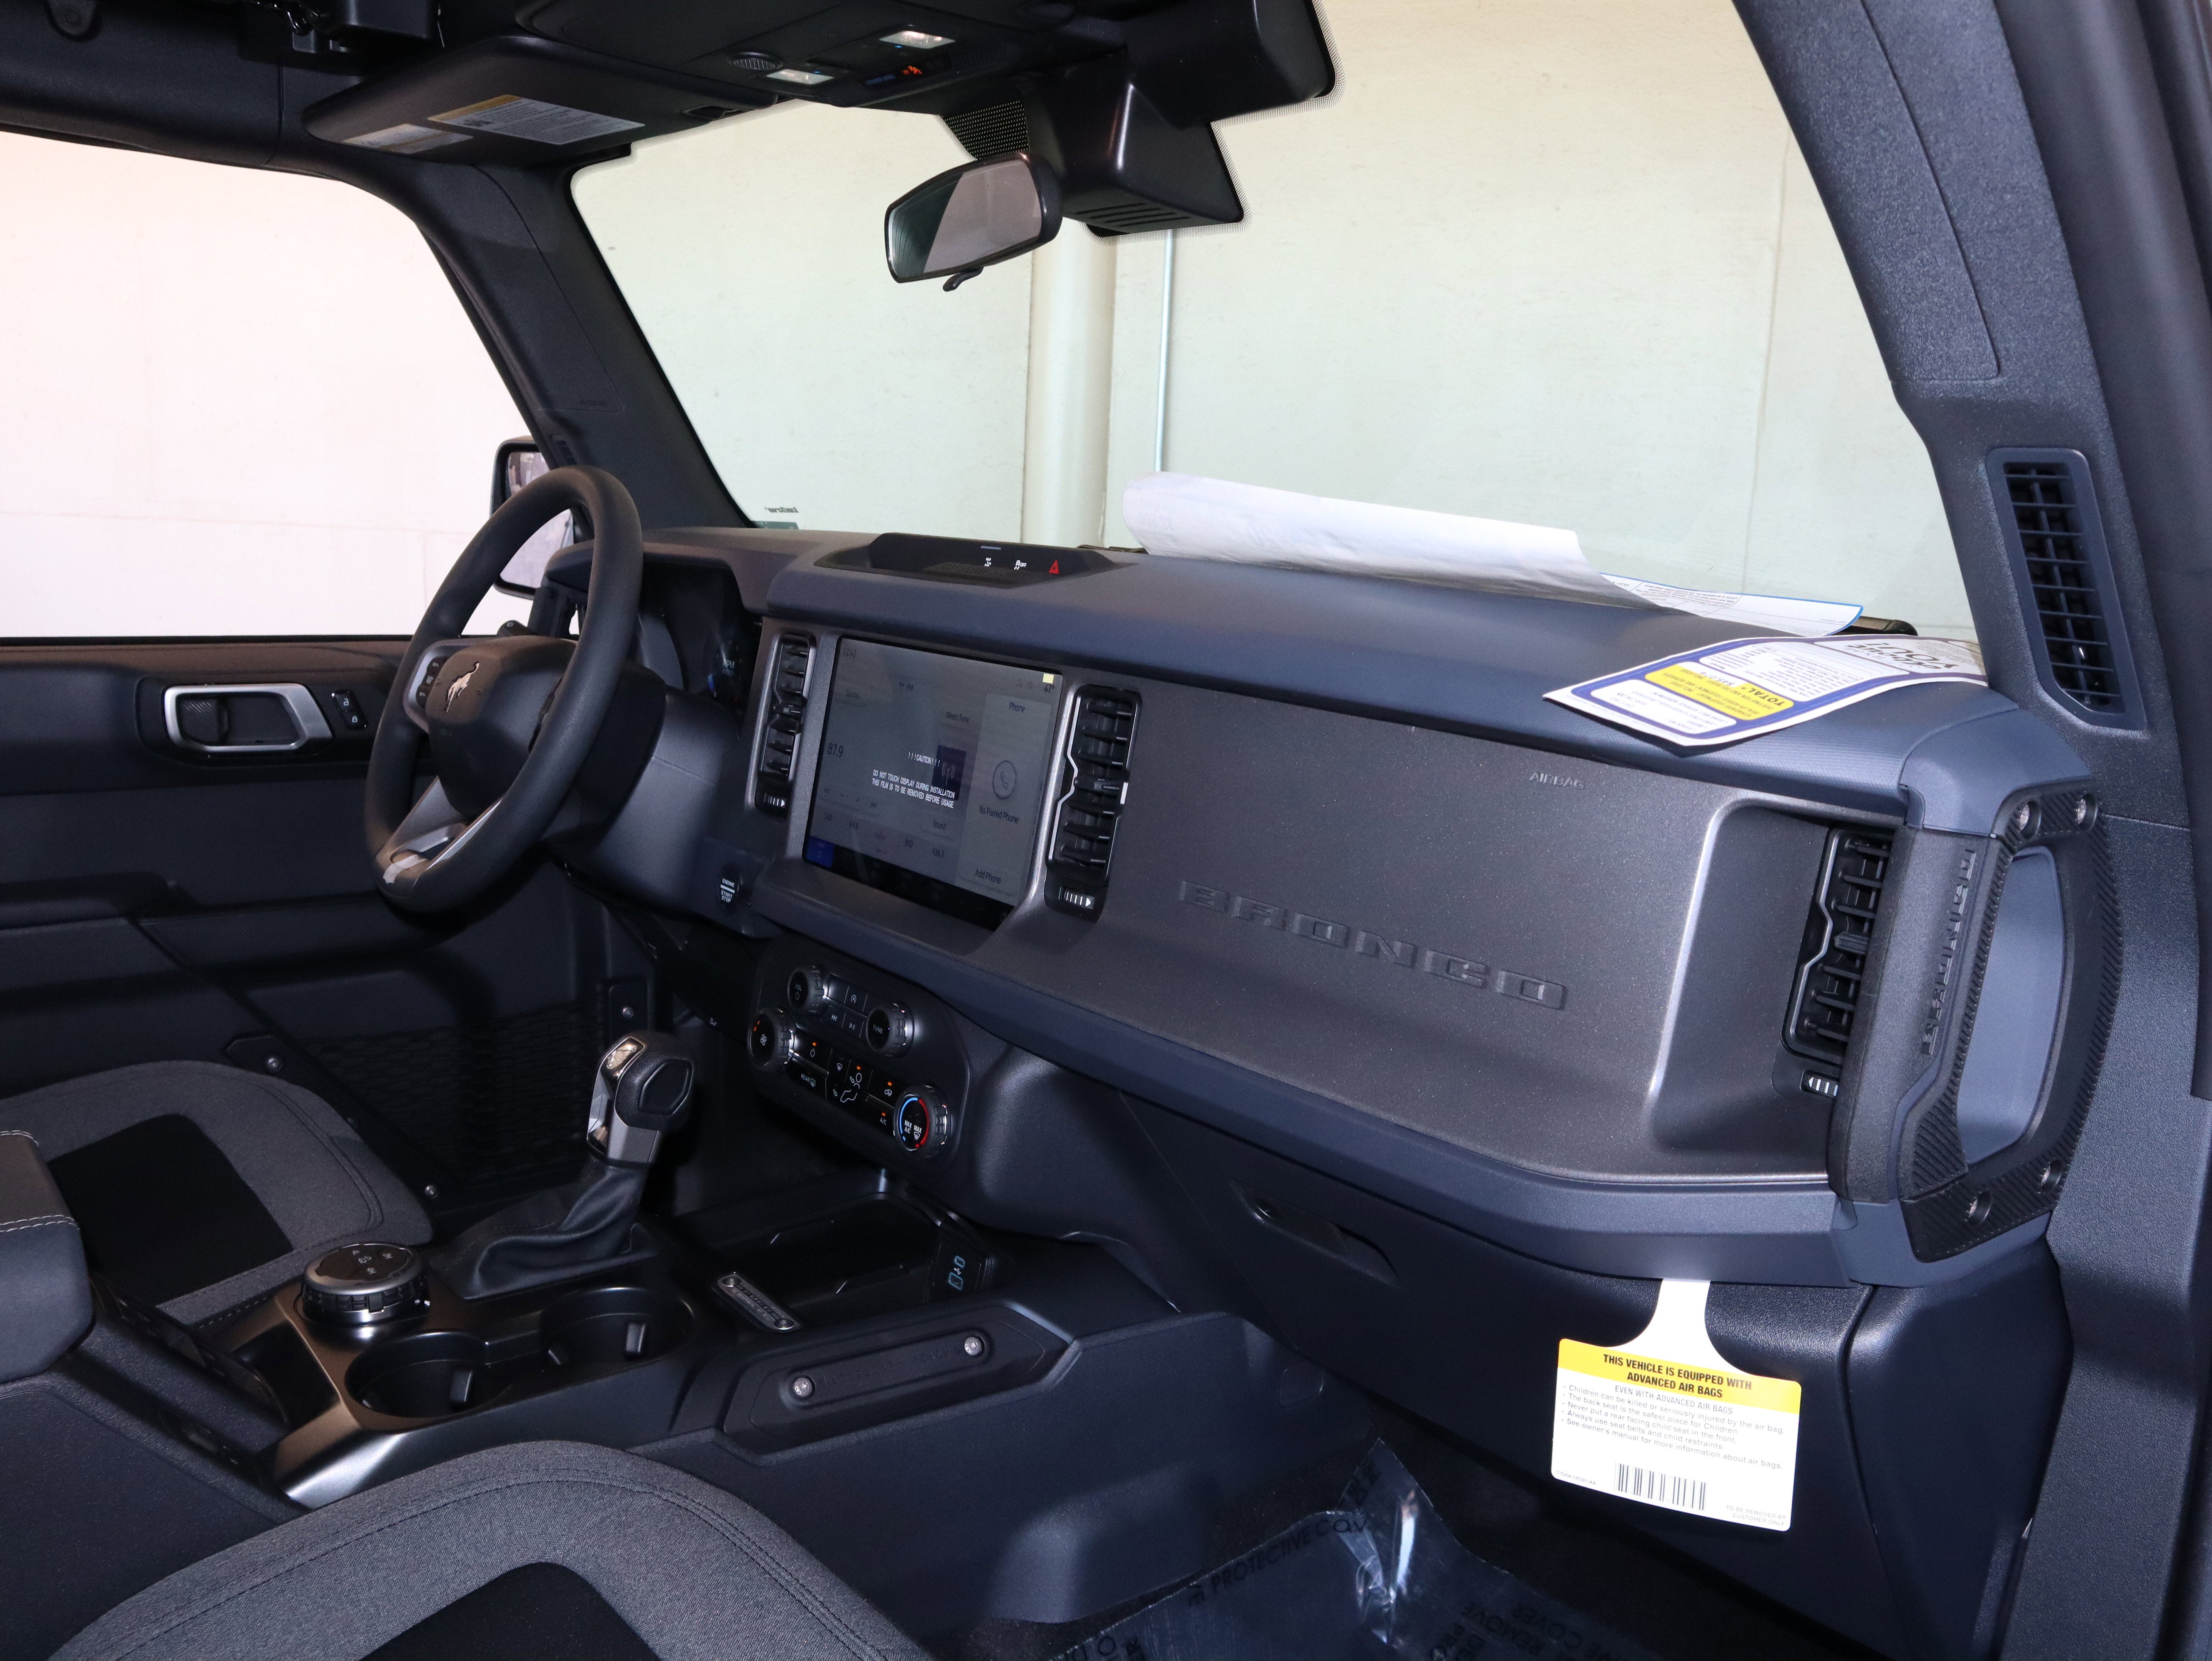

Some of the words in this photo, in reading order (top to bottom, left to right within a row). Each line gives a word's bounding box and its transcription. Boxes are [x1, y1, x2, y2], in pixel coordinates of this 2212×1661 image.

[1008, 702, 1025, 713] Phone
[945, 711, 959, 721] Direct
[958, 714, 970, 723] Tune
[827, 743, 844, 758] 87.9
[887, 773, 899, 783] TOUCH
[900, 777, 915, 787] DISPLAY
[915, 782, 929, 792] DURING
[930, 785, 955, 799] INSTALLATION
[1529, 772, 1585, 790] AIRBAG
[871, 778, 879, 786] THIS
[880, 780, 888, 789] FILM
[900, 786, 906, 794] BE
[906, 788, 925, 799] REMOVED
[925, 794, 940, 804] BEFORE
[941, 798, 954, 808] USAGE
[979, 806, 986, 814] No
[986, 808, 1002, 819] Paired
[1002, 812, 1019, 824] Phone
[932, 820, 946, 830] Sound
[904, 838, 913, 848] 810
[932, 848, 944, 858] 106.3
[974, 869, 985, 879] Add
[985, 872, 1001, 884] Phone
[721, 890, 733, 899] START
[721, 895, 731, 903] STOP
[1178, 880, 1568, 1011] BRONCO
[1920, 848, 1977, 1056] BRONCO
[873, 1024, 883, 1034] TUNE
[801, 1073, 810, 1083] REAR
[913, 1124, 922, 1134] MAX
[1603, 1353, 1623, 1366] THIS
[1625, 1358, 1663, 1374] VEHICLE
[1665, 1366, 1675, 1376] IS
[1677, 1368, 1724, 1385] EQUIPPED
[1726, 1377, 1752, 1390] WITH
[1626, 1372, 1676, 1389] ADVANCED
[1678, 1382, 1695, 1393] AIR
[1697, 1385, 1723, 1398] BAGS
[1615, 1385, 1633, 1395] EVEN
[1635, 1389, 1654, 1399] WITH
[1656, 1394, 1695, 1407] ADVANCED
[1697, 1402, 1710, 1410] AIR
[1713, 1404, 1732, 1414] BAGS
[1568, 1392, 1581, 1401] The
[1583, 1397, 1600, 1406] back
[1642, 1411, 1665, 1421] safest
[1704, 1423, 1739, 1434] Children.
[1569, 1384, 1598, 1397] Children
[1627, 1398, 1647, 1408] killed
[1660, 1406, 1695, 1419] seriously
[1698, 1414, 1725, 1423] injured
[1728, 1418, 1737, 1426] by
[1767, 1425, 1784, 1434] bag.
[1567, 1410, 1592, 1421] Always
[1627, 1424, 1645, 1434] belts
[1685, 1438, 1722, 1449] restraints.
[1568, 1401, 1588, 1411] Never
[1627, 1416, 1649, 1427] facing
[1716, 1433, 1736, 1443] front.
[1566, 1418, 1579, 1426] See
[1582, 1423, 1609, 1434] owner's
[1612, 1431, 1638, 1441] manual
[1654, 1440, 1673, 1448] more
[1676, 1445, 1720, 1458] information
[1723, 1454, 1745, 1463] about
[1761, 1460, 1782, 1469] bags.
[1732, 1513, 1766, 1522] CUSTOMER
[1746, 1509, 1776, 1518] REMOVED
[1211, 1527, 1311, 1595] PROTECTIVE
